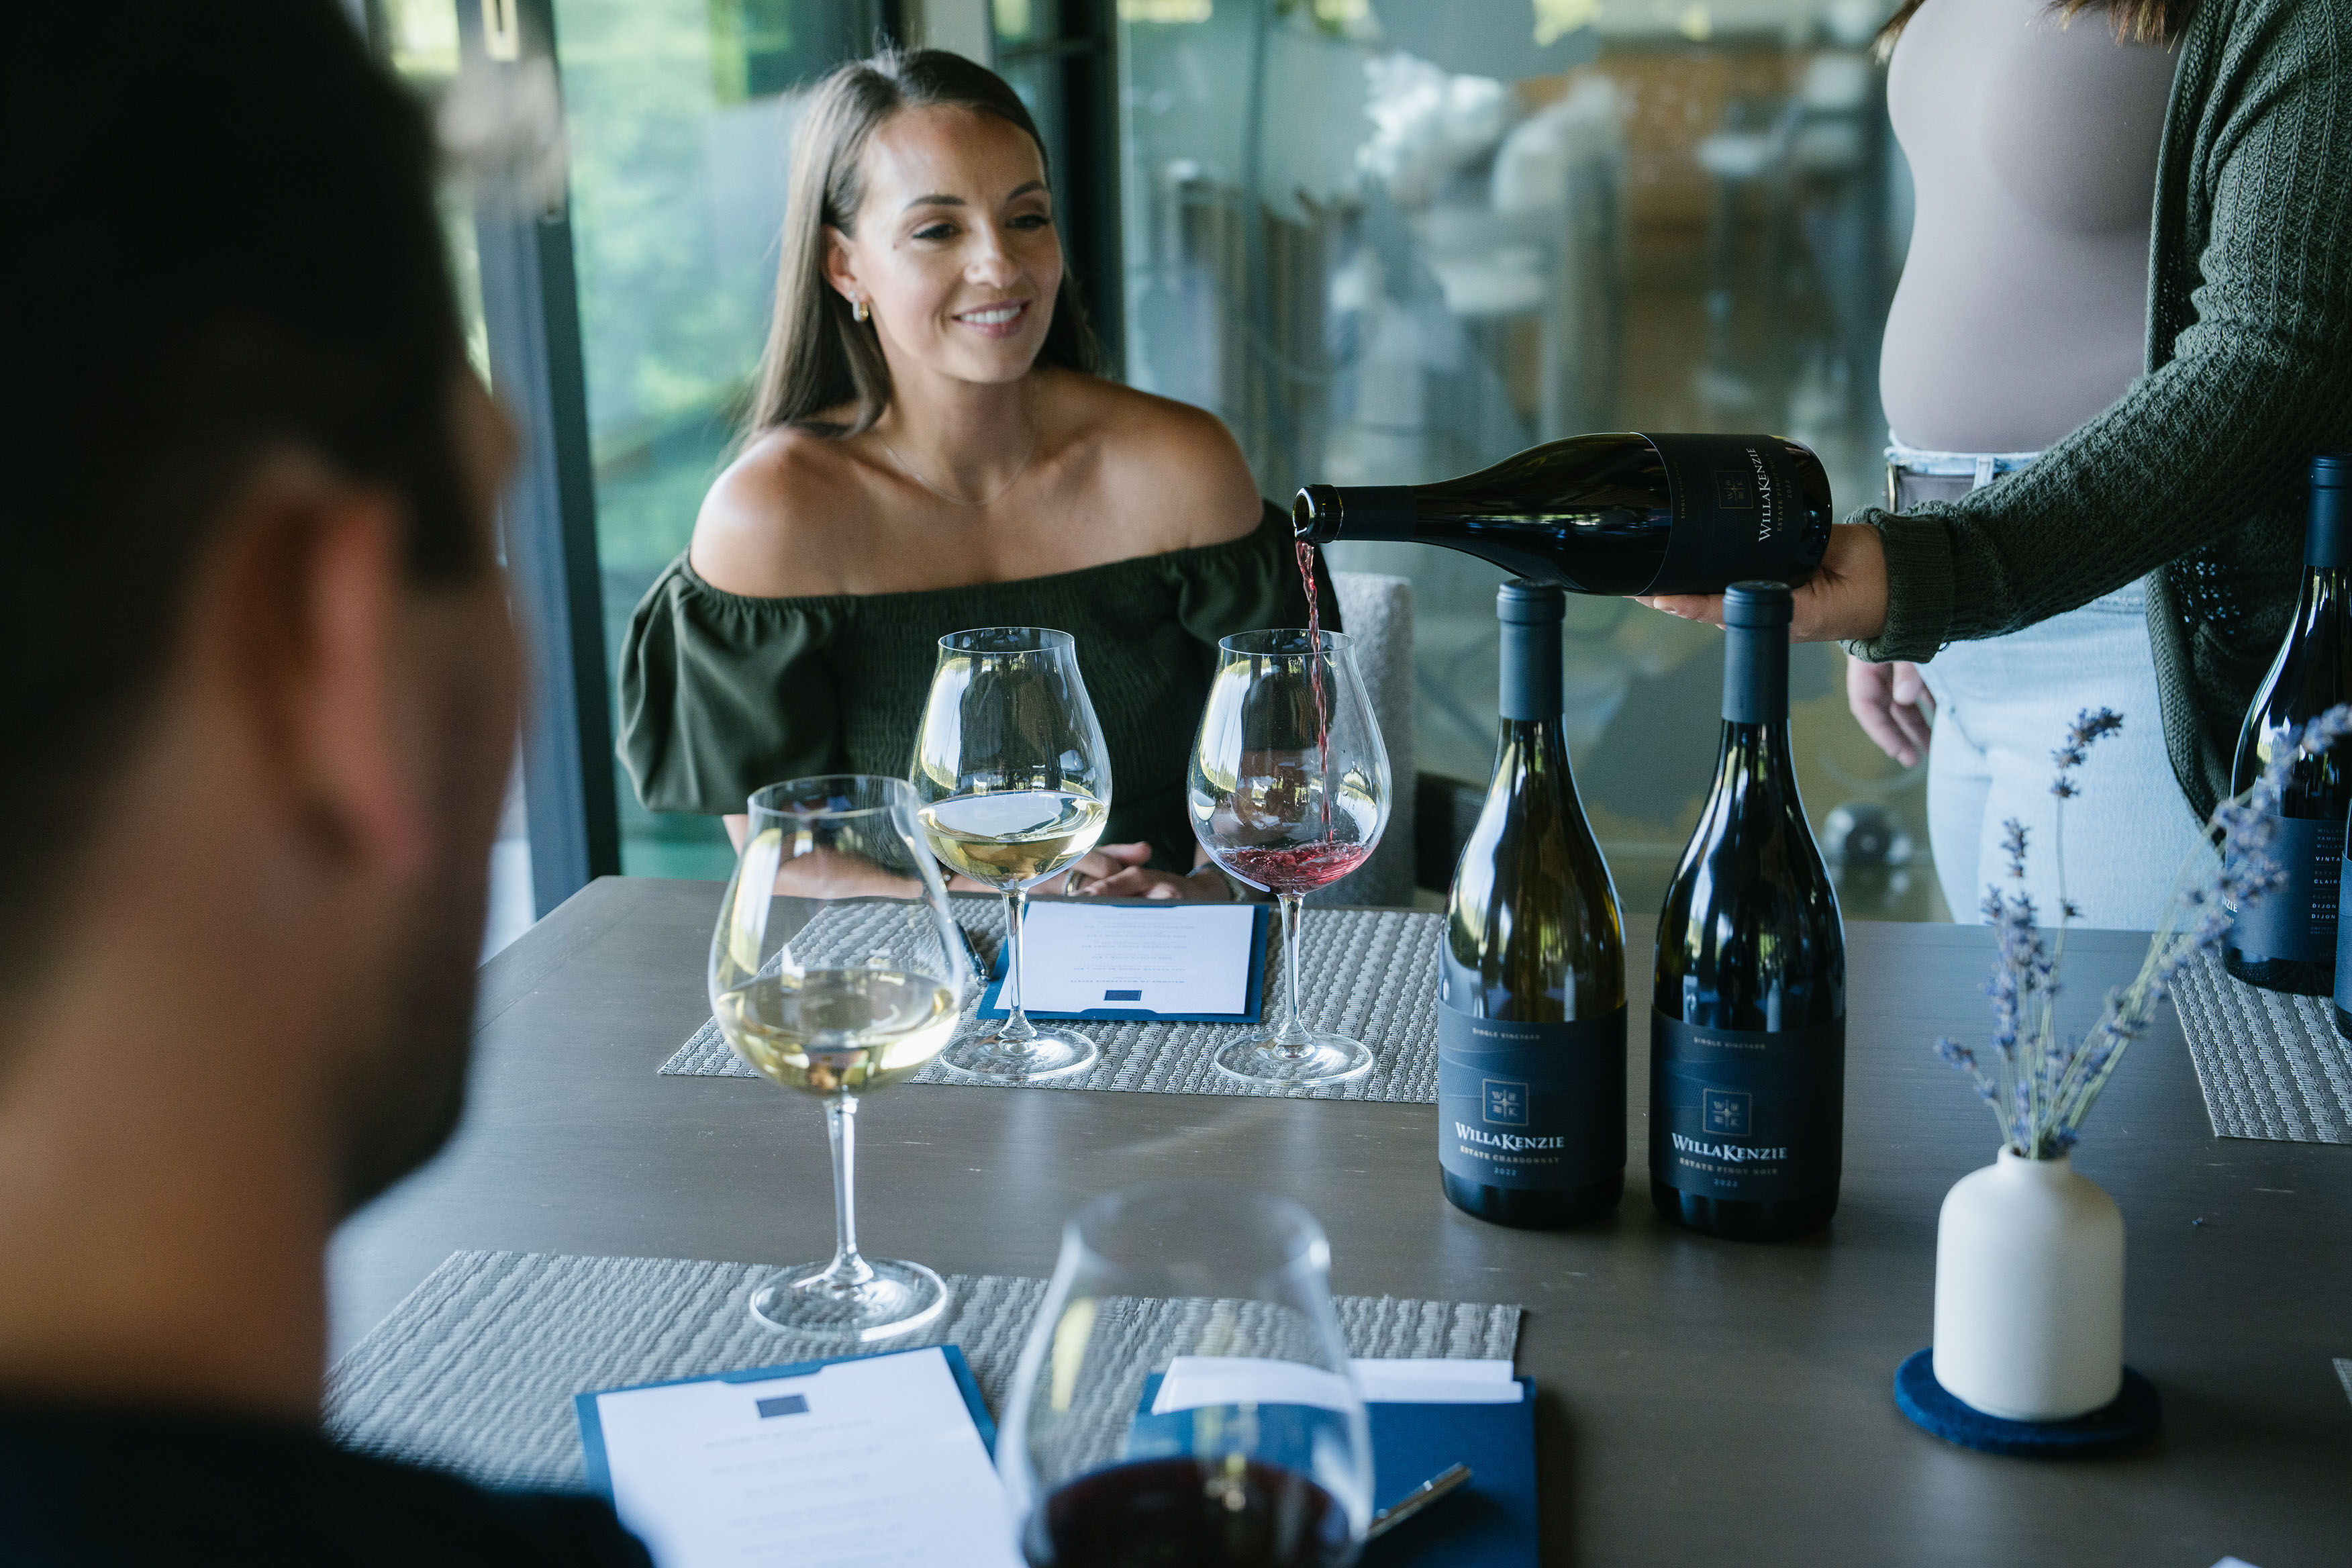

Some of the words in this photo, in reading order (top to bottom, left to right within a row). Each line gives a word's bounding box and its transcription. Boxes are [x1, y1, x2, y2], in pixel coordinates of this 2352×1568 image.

[1746, 448, 1772, 542] WILLAKENZIE
[1455, 1122, 1565, 1152] WILLAKENZIE
[1671, 1132, 1789, 1163] WILLAKENZIE
[1459, 1144, 1490, 1161] ESTATE
[1492, 1154, 1560, 1165] CHARDONNAY
[1493, 1167, 1517, 1176] 2022
[1679, 1157, 1714, 1173] ESTATE
[1716, 1165, 1749, 1174] PINOT
[1713, 1178, 1738, 1187] 2022
